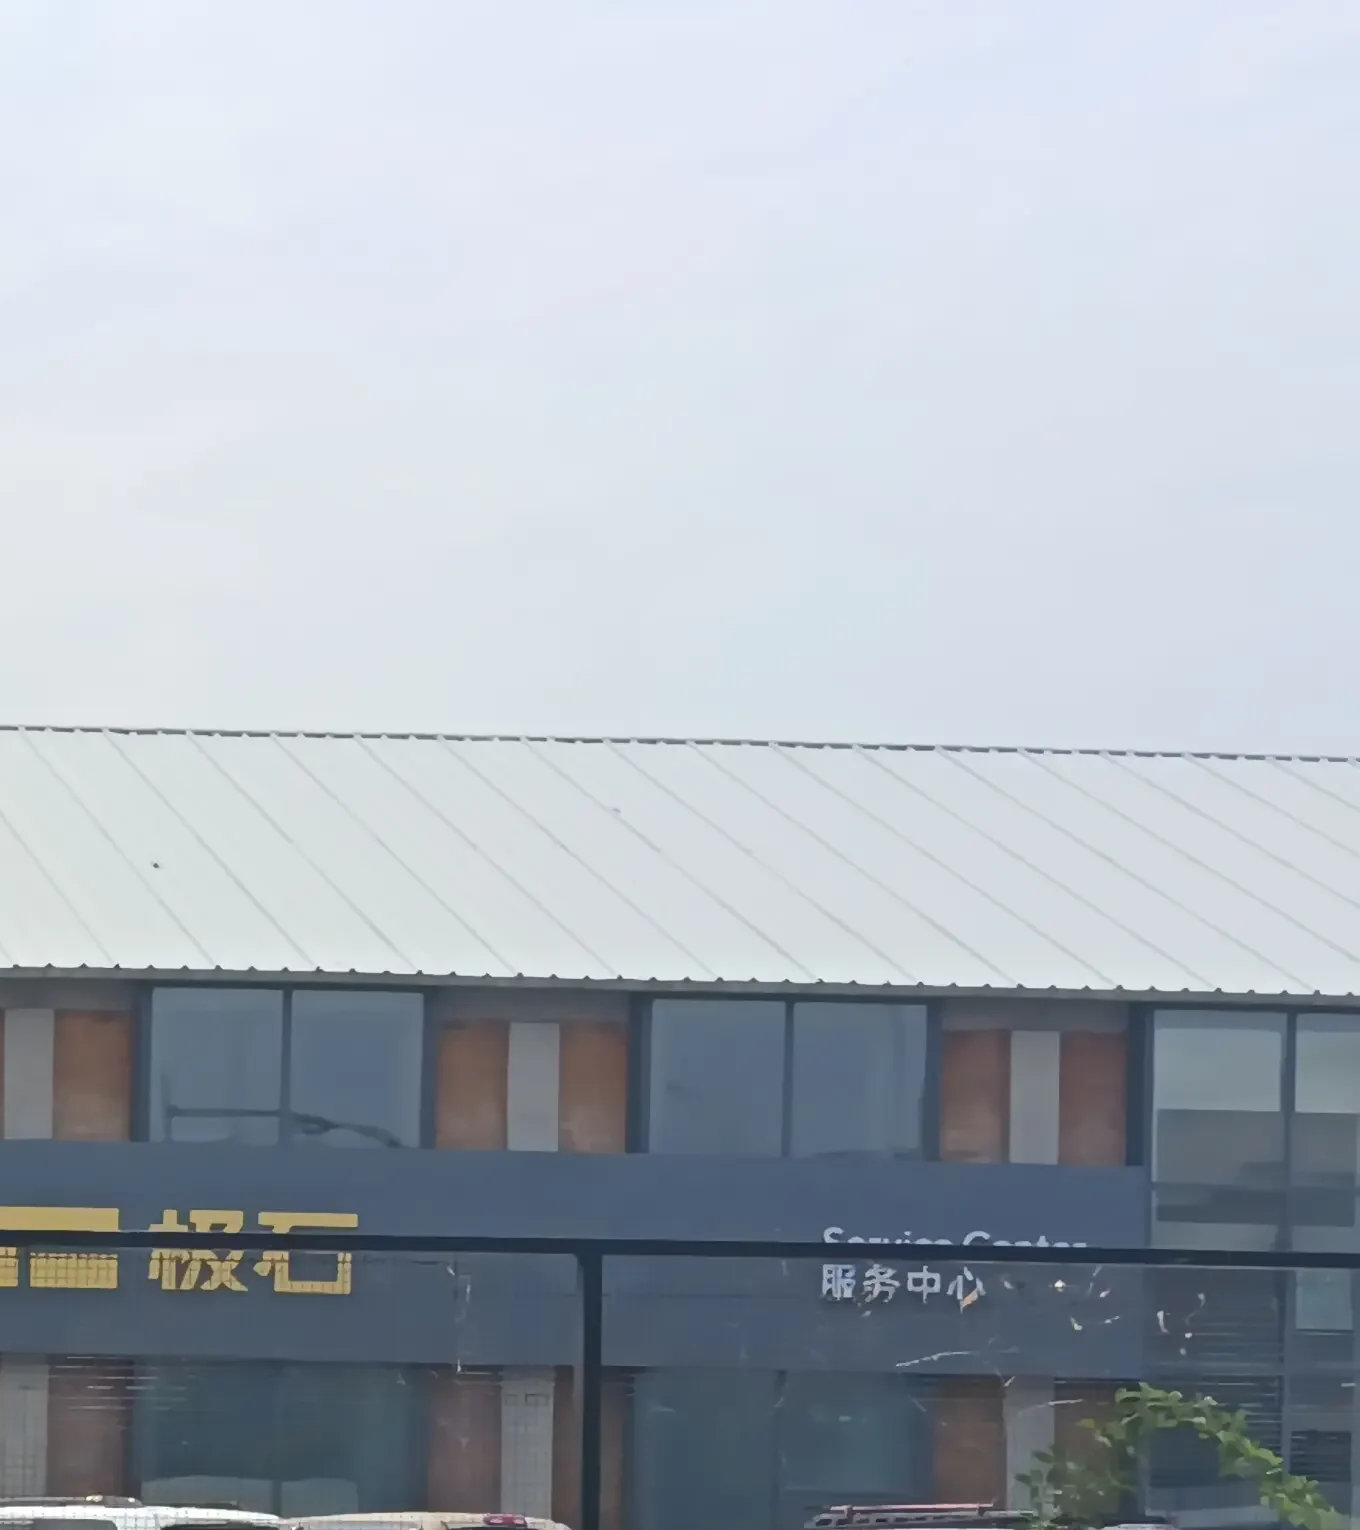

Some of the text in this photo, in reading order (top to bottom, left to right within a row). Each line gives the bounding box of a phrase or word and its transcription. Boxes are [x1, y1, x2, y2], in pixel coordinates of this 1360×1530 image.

[148, 1209, 359, 1295] 极石
[822, 1264, 986, 1304] 服务中心
